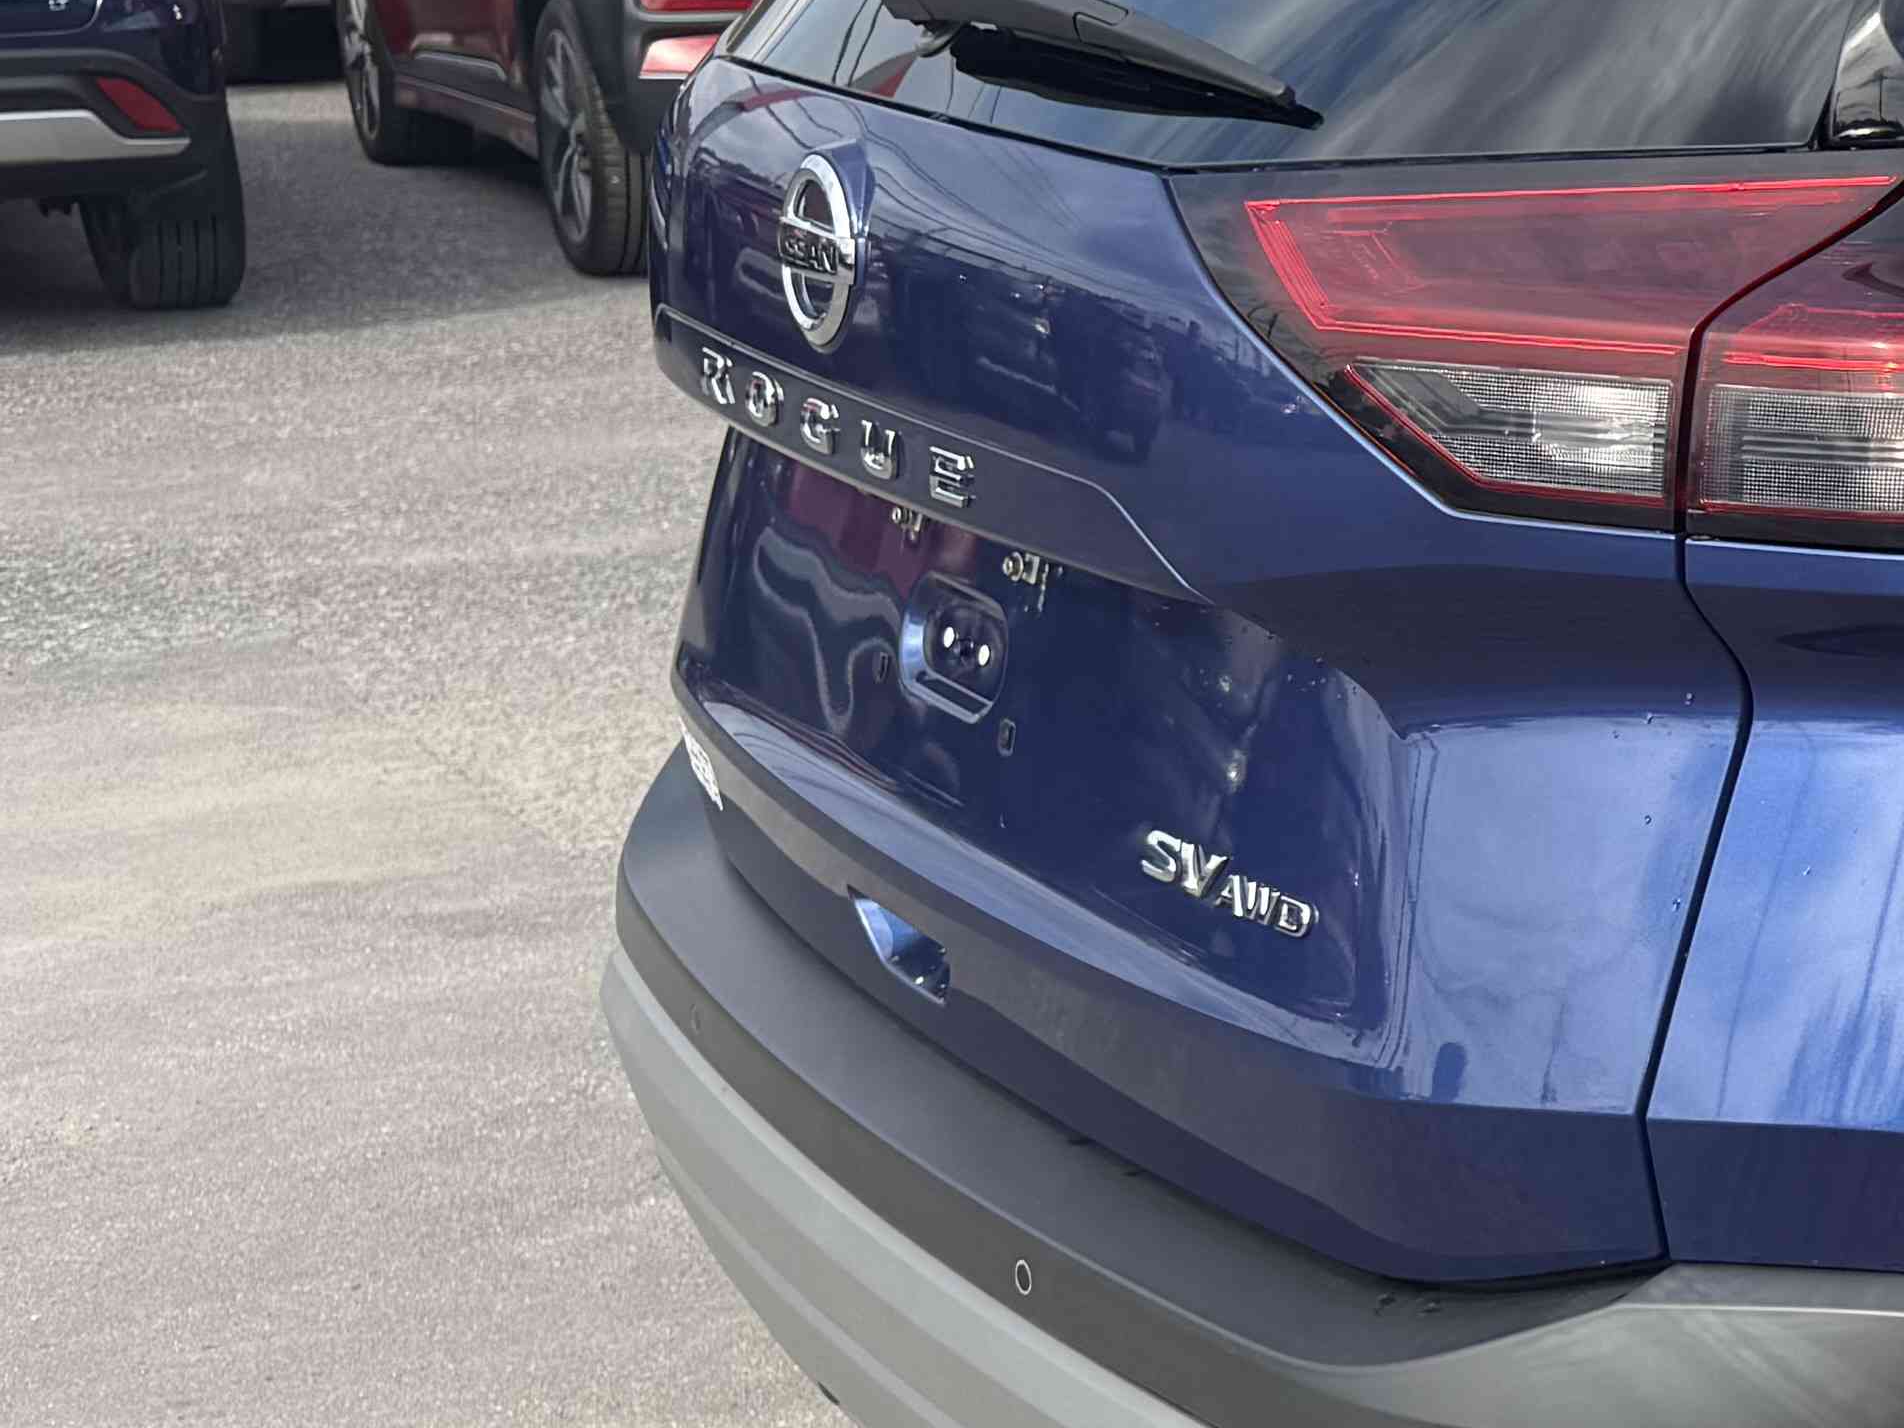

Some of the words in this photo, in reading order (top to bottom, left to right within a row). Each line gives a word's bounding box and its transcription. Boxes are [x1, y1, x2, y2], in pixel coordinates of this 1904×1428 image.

[700, 346, 977, 510] ROGUE
[1141, 829, 1232, 899] SV
[1213, 873, 1320, 938] AWD
